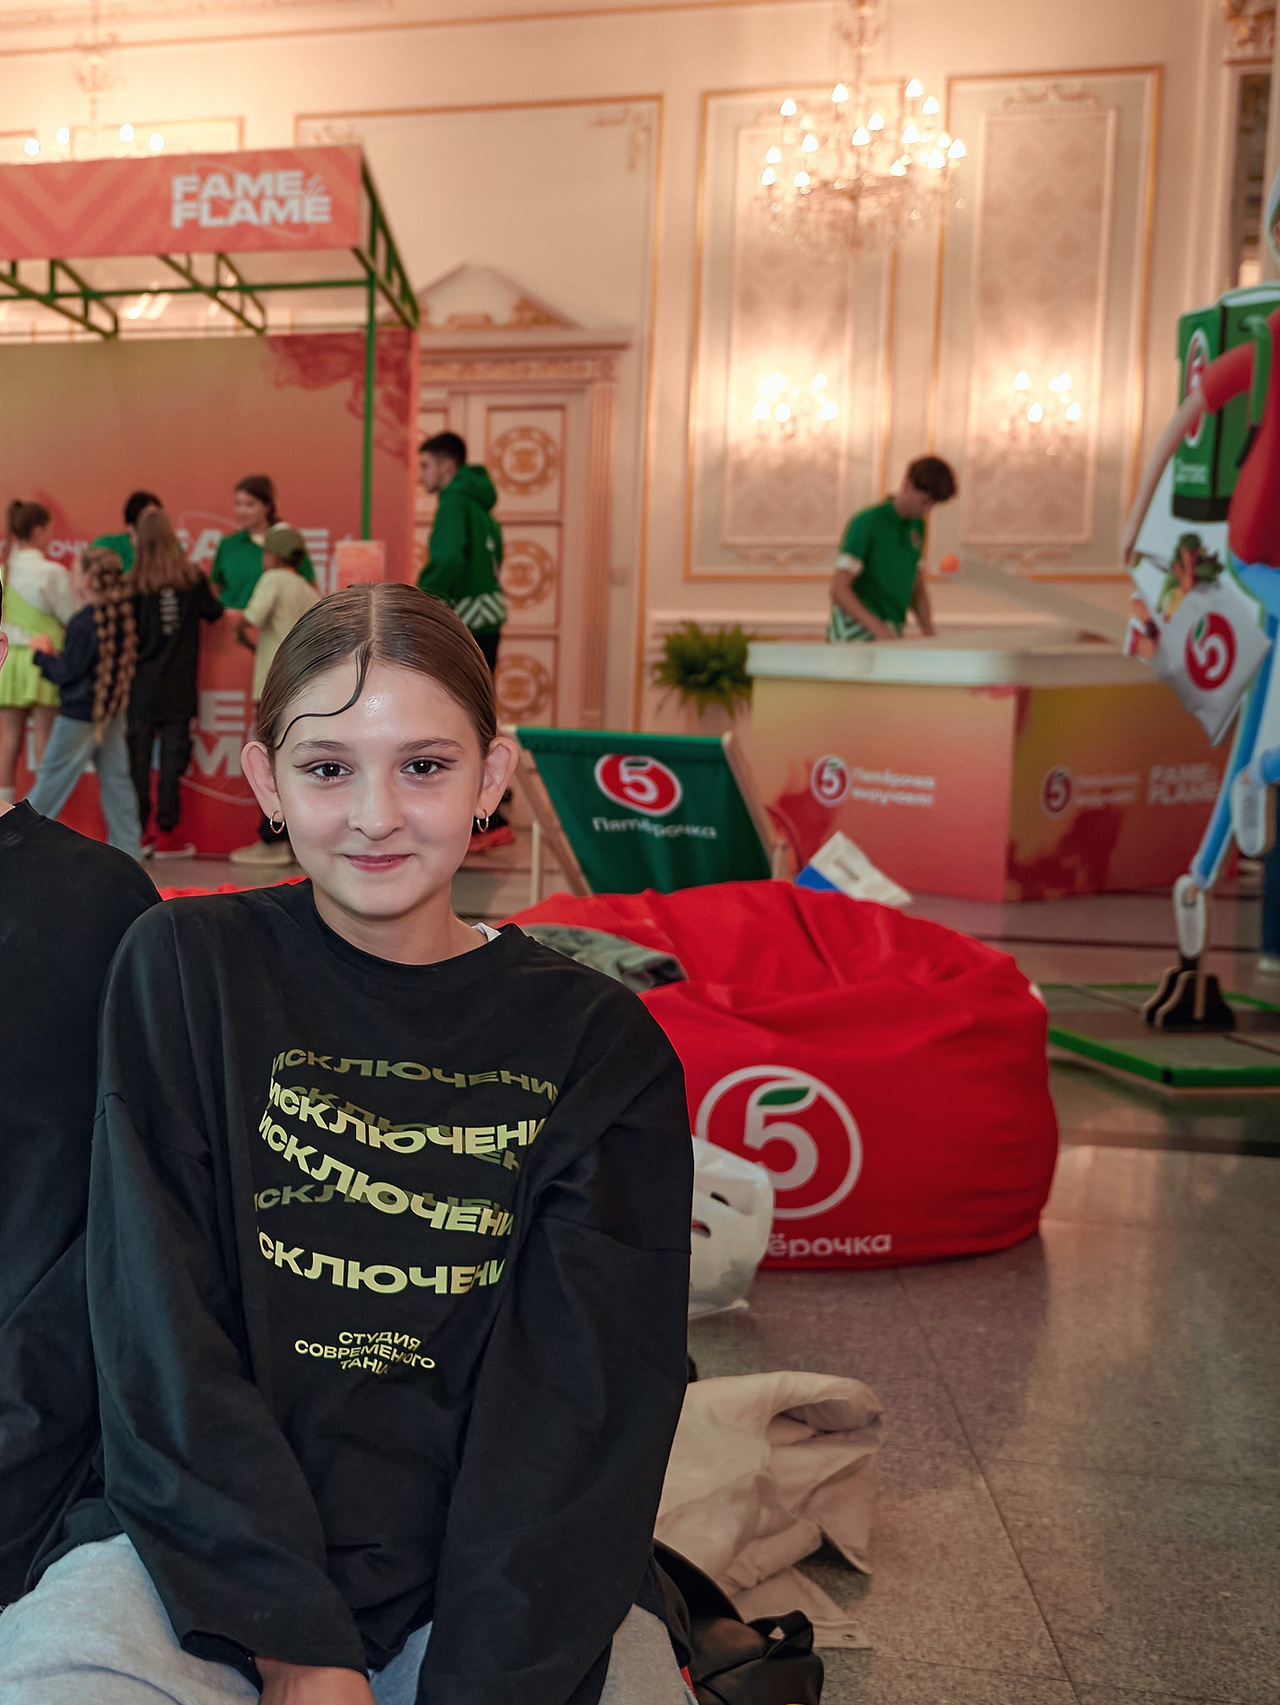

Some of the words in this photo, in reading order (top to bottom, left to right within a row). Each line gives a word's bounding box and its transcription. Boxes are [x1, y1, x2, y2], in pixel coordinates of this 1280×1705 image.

[173, 170, 303, 202] FAME
[172, 195, 331, 229] FLAME
[592, 816, 717, 839] Пятёрочка
[271, 1049, 559, 1105] ИСКЛЮЧЕНИ
[744, 1078, 818, 1191] 5
[257, 1226, 506, 1294] СКЛЮЧЕНИ
[767, 1232, 892, 1258] ёрочка
[339, 1331, 421, 1351] СТУДИЯ
